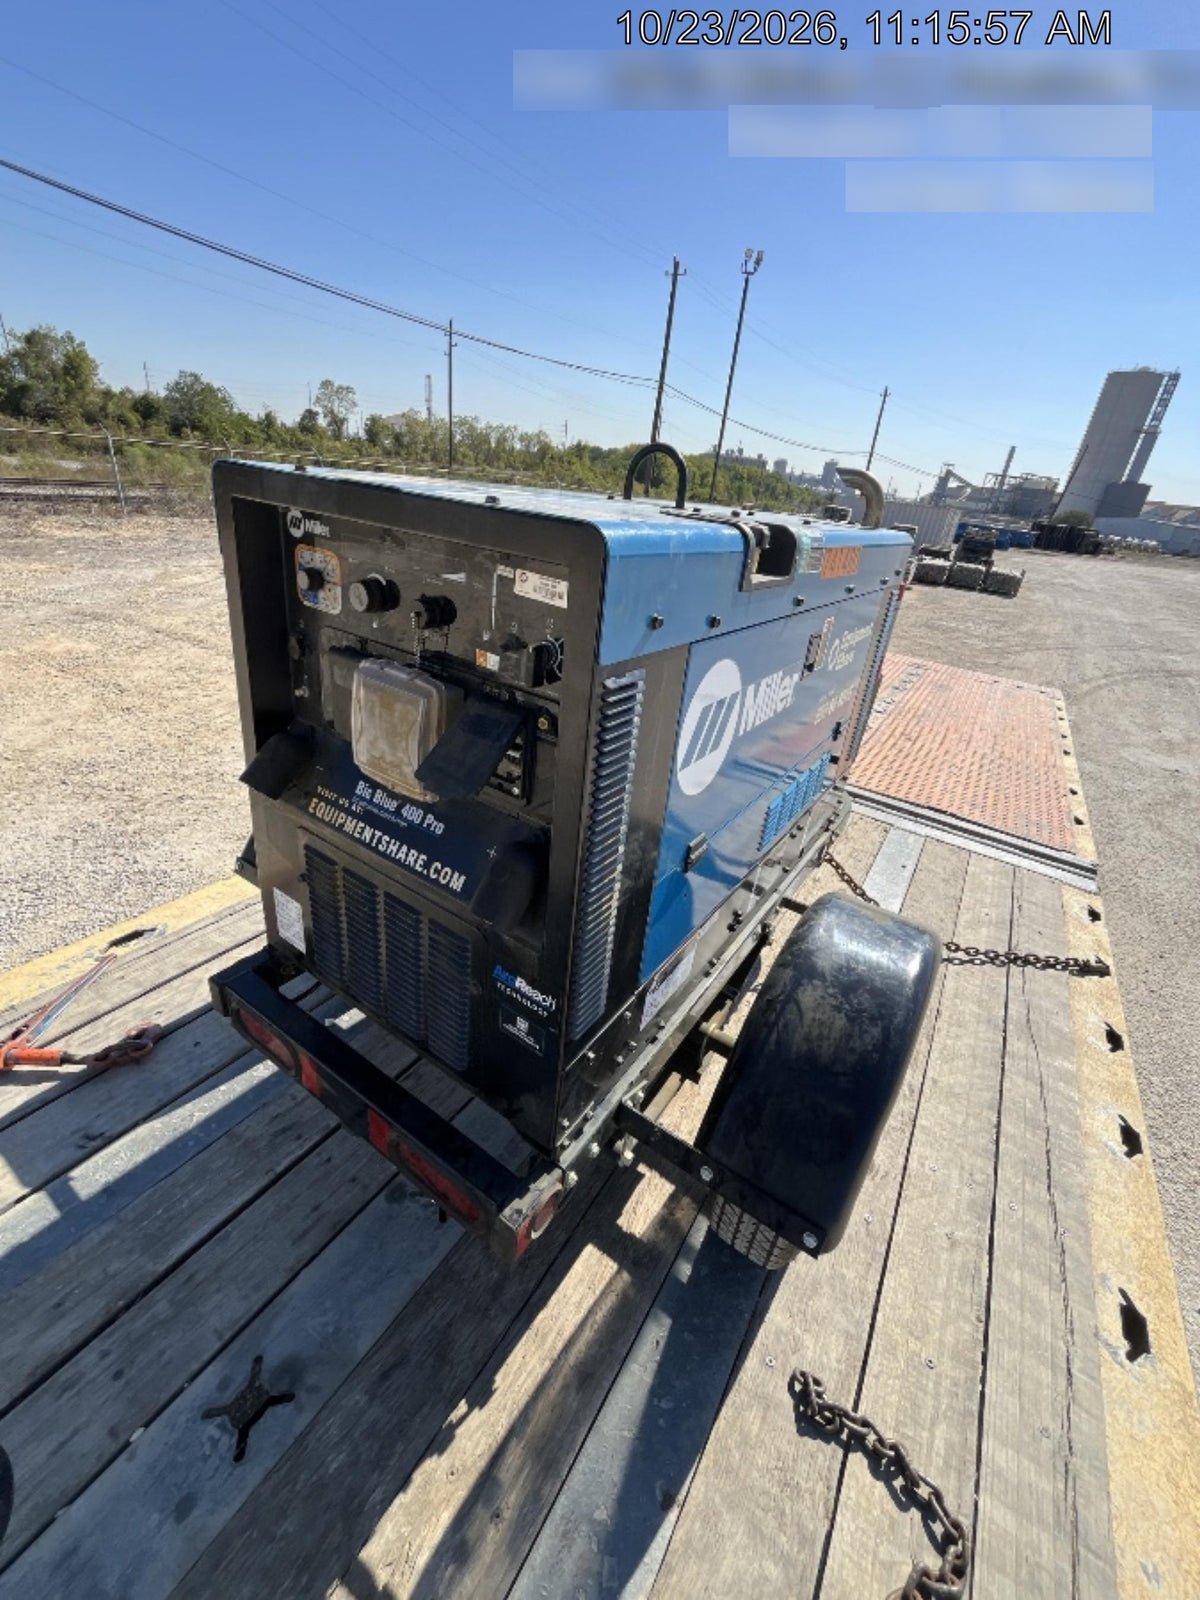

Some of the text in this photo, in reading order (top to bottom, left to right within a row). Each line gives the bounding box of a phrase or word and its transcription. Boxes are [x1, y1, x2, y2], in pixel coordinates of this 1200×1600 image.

[737, 670, 801, 737] Miller
[308, 797, 467, 893] EQUIPMENTSHARE.COM
[372, 789, 399, 812] Blue
[401, 803, 424, 824] 400
[422, 813, 445, 835] Pro
